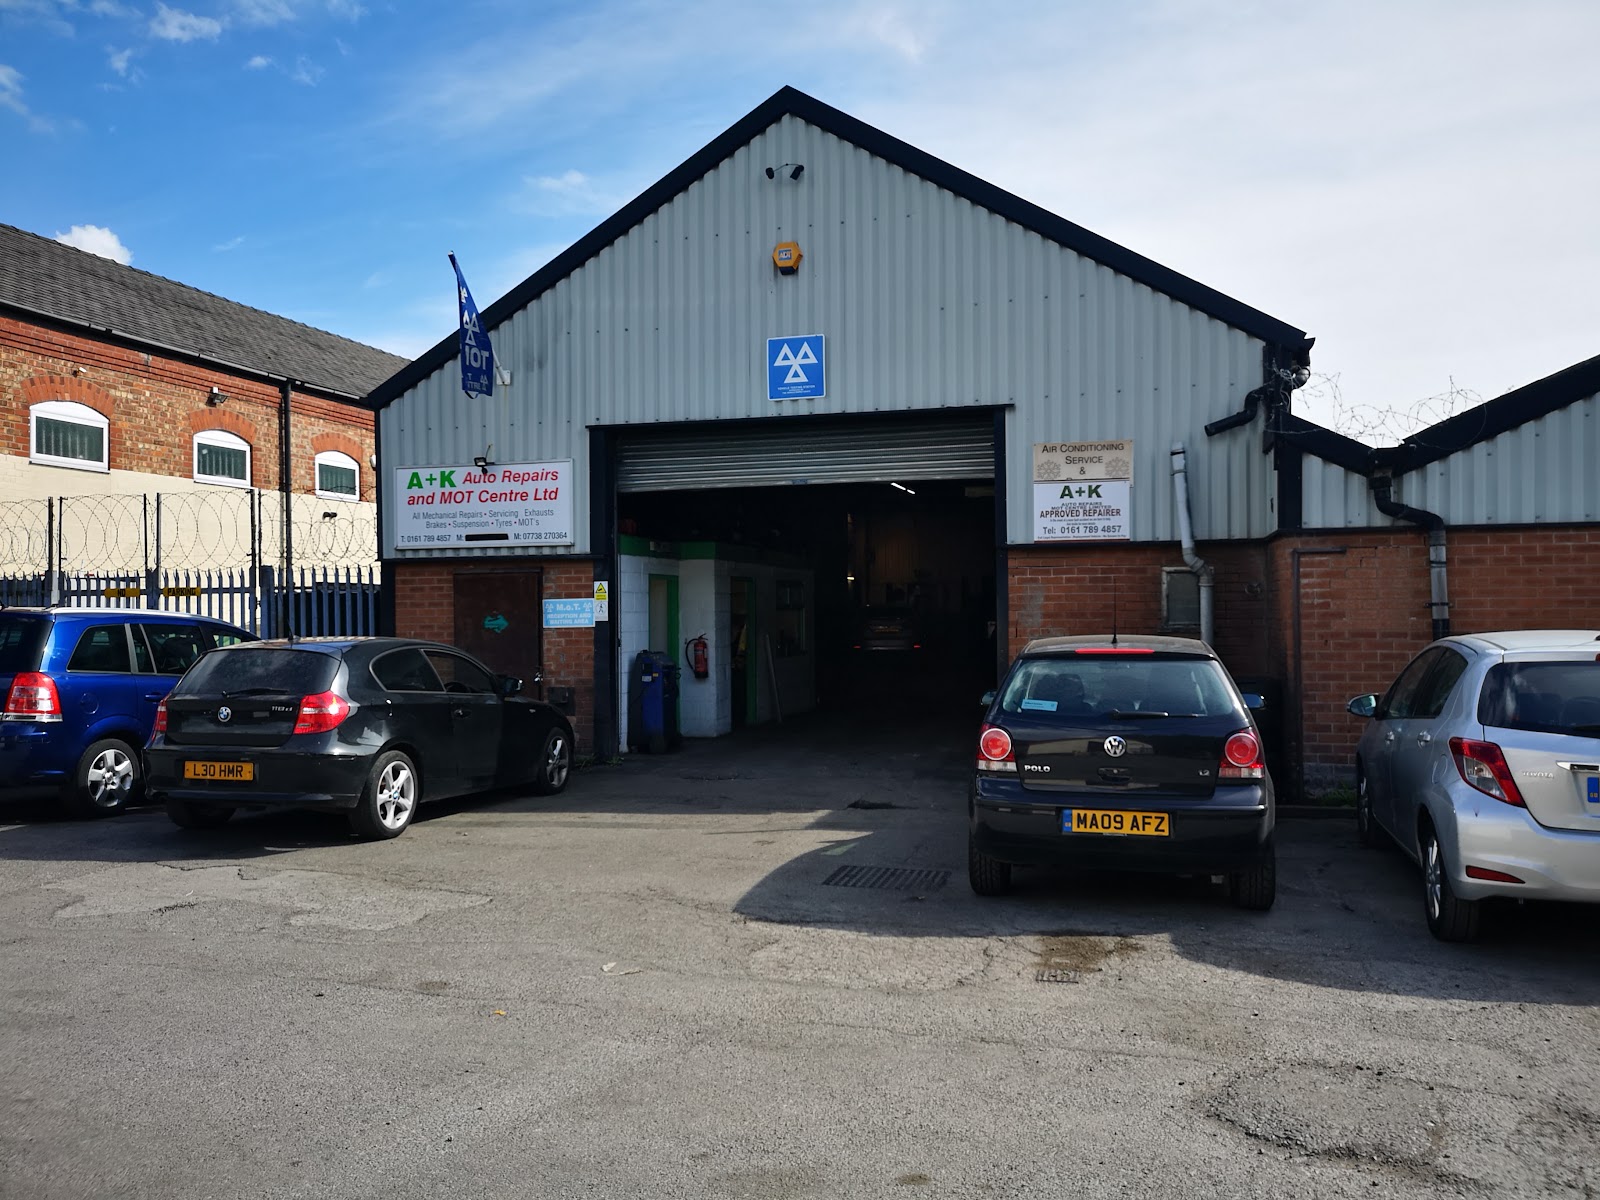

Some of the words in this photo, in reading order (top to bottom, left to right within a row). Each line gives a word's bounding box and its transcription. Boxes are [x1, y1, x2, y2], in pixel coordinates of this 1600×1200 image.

[1060, 443, 1125, 453] CONDITIONING
[1065, 456, 1103, 465] SERVICE
[1079, 466, 1086, 475] &
[407, 470, 456, 489] A+K
[462, 471, 496, 485] Auto
[501, 468, 559, 486] Repairs
[407, 492, 435, 505] and
[440, 490, 474, 504] MOT
[478, 489, 529, 503] Centre
[533, 487, 559, 501] Ltd
[1059, 485, 1103, 499] A+K
[412, 512, 421, 520] All
[422, 511, 457, 520] Mechanical
[459, 510, 483, 521] Repairs
[488, 510, 519, 519] Servicing
[525, 508, 554, 517] Exhausts
[1040, 509, 1081, 519] APPROVED
[1083, 508, 1121, 517] REPAIRER
[426, 520, 447, 529] Brakes
[452, 519, 489, 529] Suspension
[495, 518, 512, 529] Tyres
[518, 518, 540, 526] MOT's
[1043, 526, 1056, 535] Tel:
[1060, 526, 1080, 534] 0161
[1083, 525, 1099, 534] 789
[1101, 524, 1122, 533] 4857
[407, 535, 422, 543] 0161
[436, 534, 451, 542] 4857
[523, 532, 542, 540] 07738
[544, 531, 568, 540] 270364
[168, 588, 196, 596] PARKING
[219, 764, 243, 778] HMR
[1024, 764, 1051, 773] POLO
[1076, 812, 1124, 830] MA09
[1130, 815, 1166, 833] AFZ
